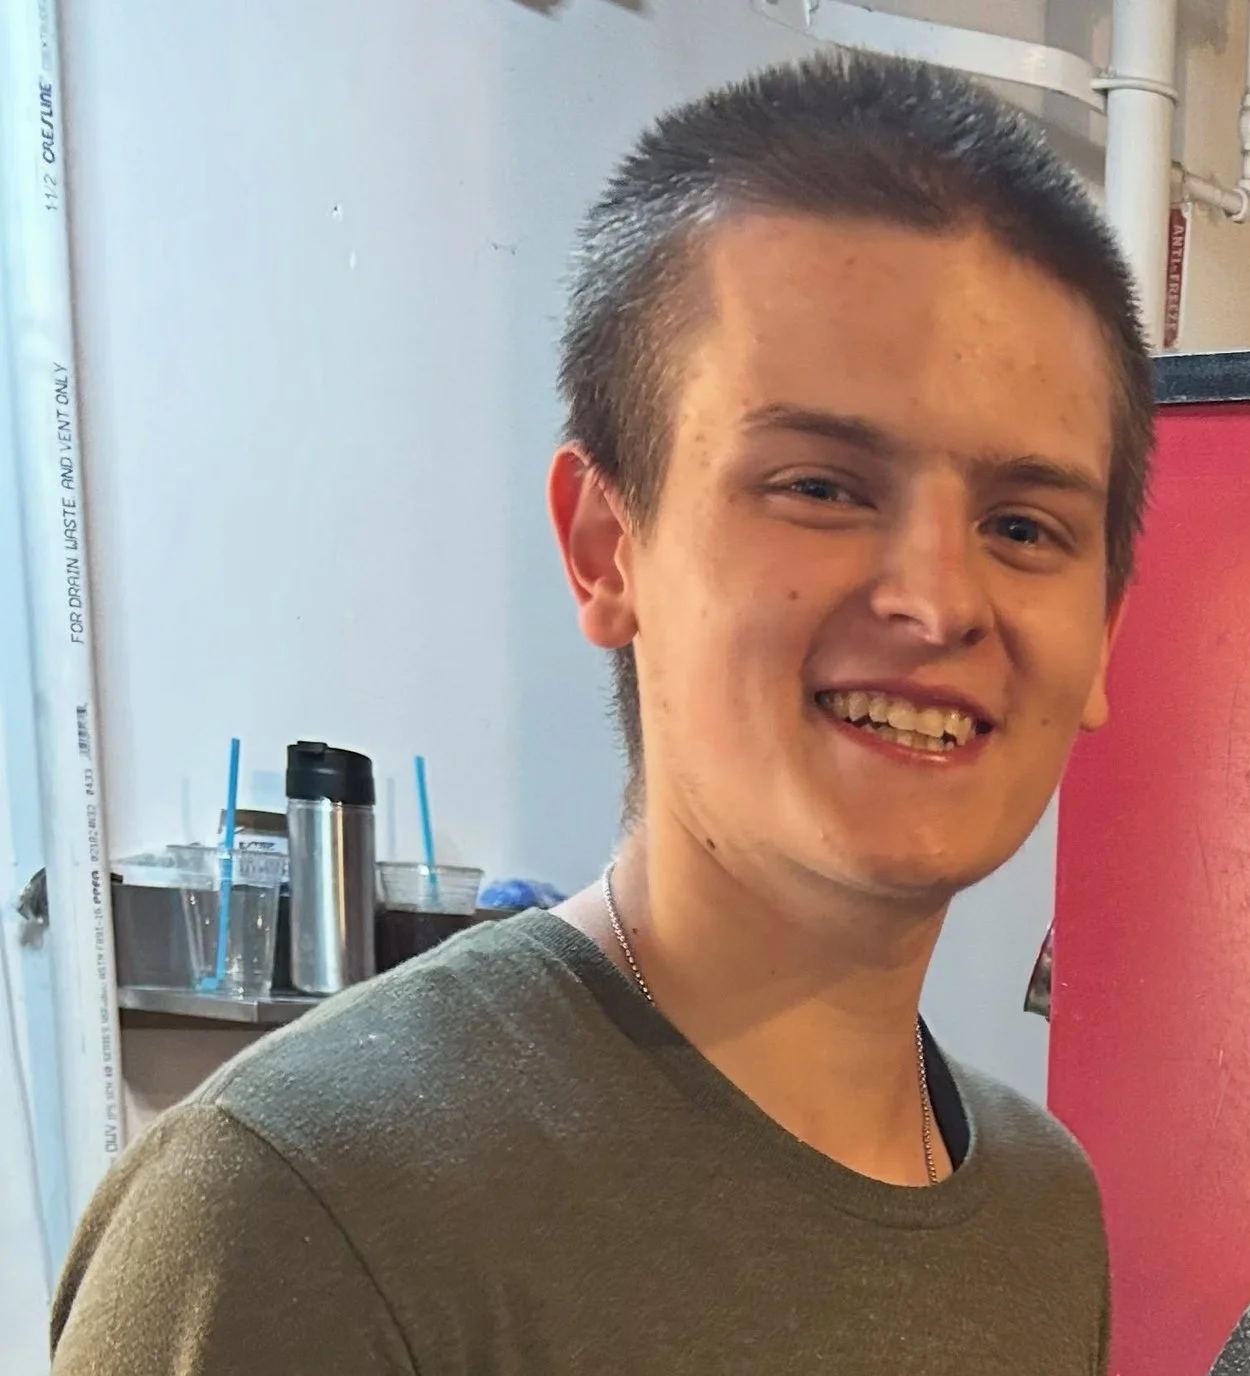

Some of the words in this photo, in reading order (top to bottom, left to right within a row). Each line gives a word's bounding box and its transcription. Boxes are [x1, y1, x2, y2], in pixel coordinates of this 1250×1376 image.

[38, 80, 56, 164] CRESLINE
[1168, 224, 1185, 331] ANTI-FREEZE
[52, 362, 69, 405] ONLY
[56, 409, 72, 452] VENT
[59, 457, 75, 490] AND
[61, 497, 79, 551] WASTE
[66, 557, 83, 608] DRAIN
[69, 611, 84, 644] FOR
